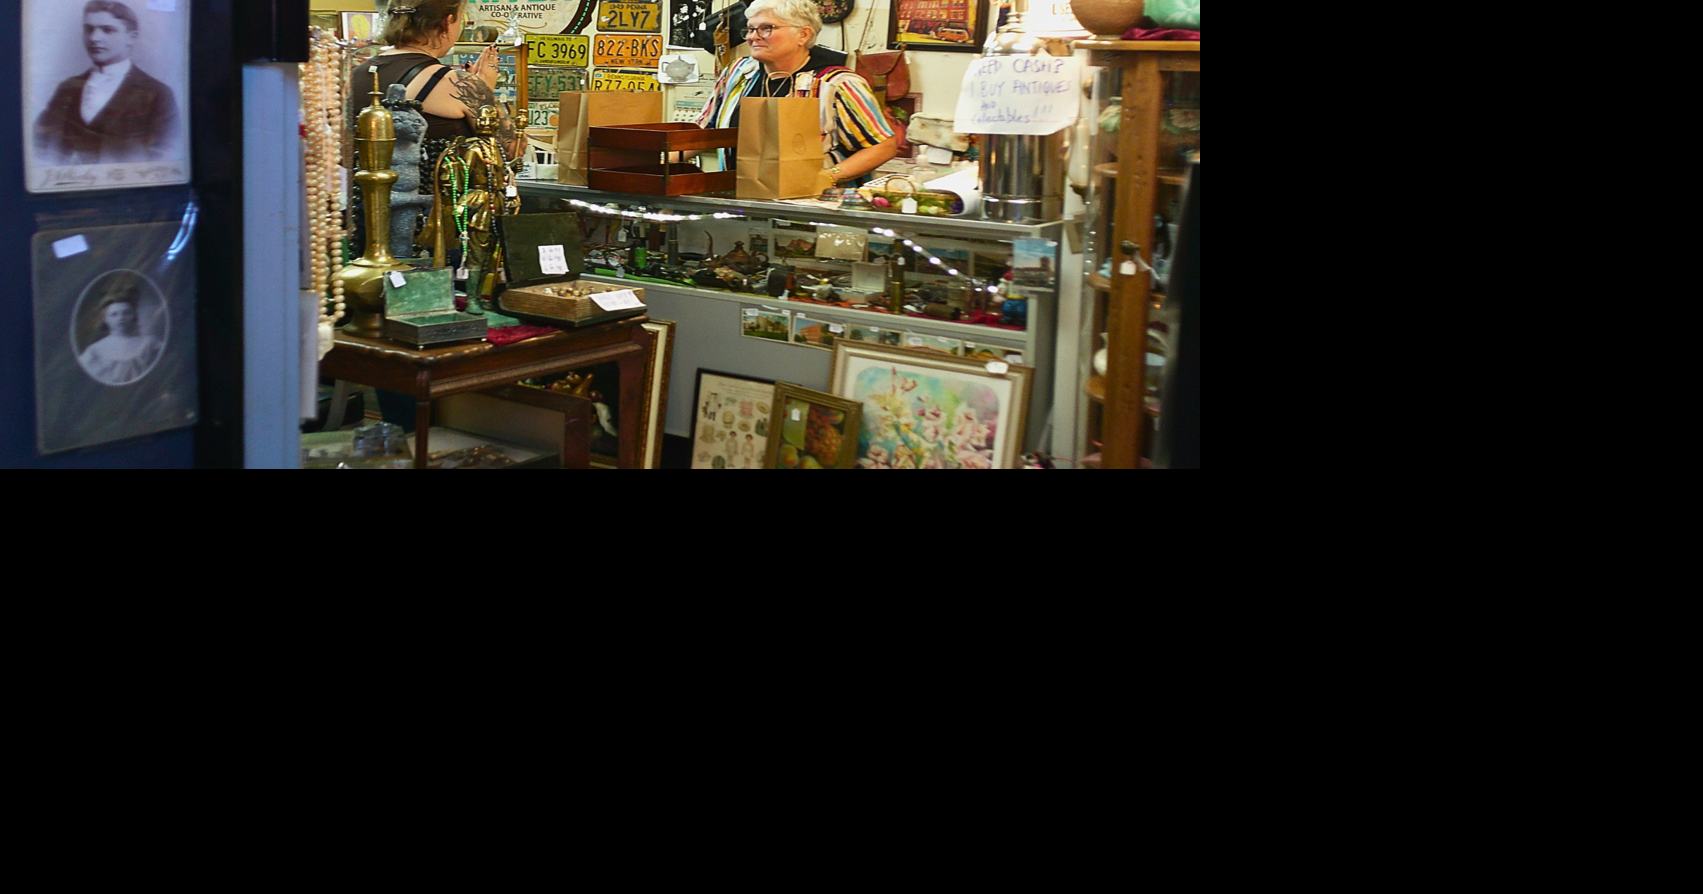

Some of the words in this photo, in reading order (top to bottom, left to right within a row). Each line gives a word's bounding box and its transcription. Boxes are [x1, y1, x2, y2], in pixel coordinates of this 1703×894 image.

[607, 10, 651, 28] 2LY7
[551, 43, 586, 59] 3969
[597, 39, 659, 57] 822-BKS
[1013, 58, 1064, 74] CASH?
[980, 80, 1006, 97] BUY
[1012, 79, 1073, 96] ANTIQUES
